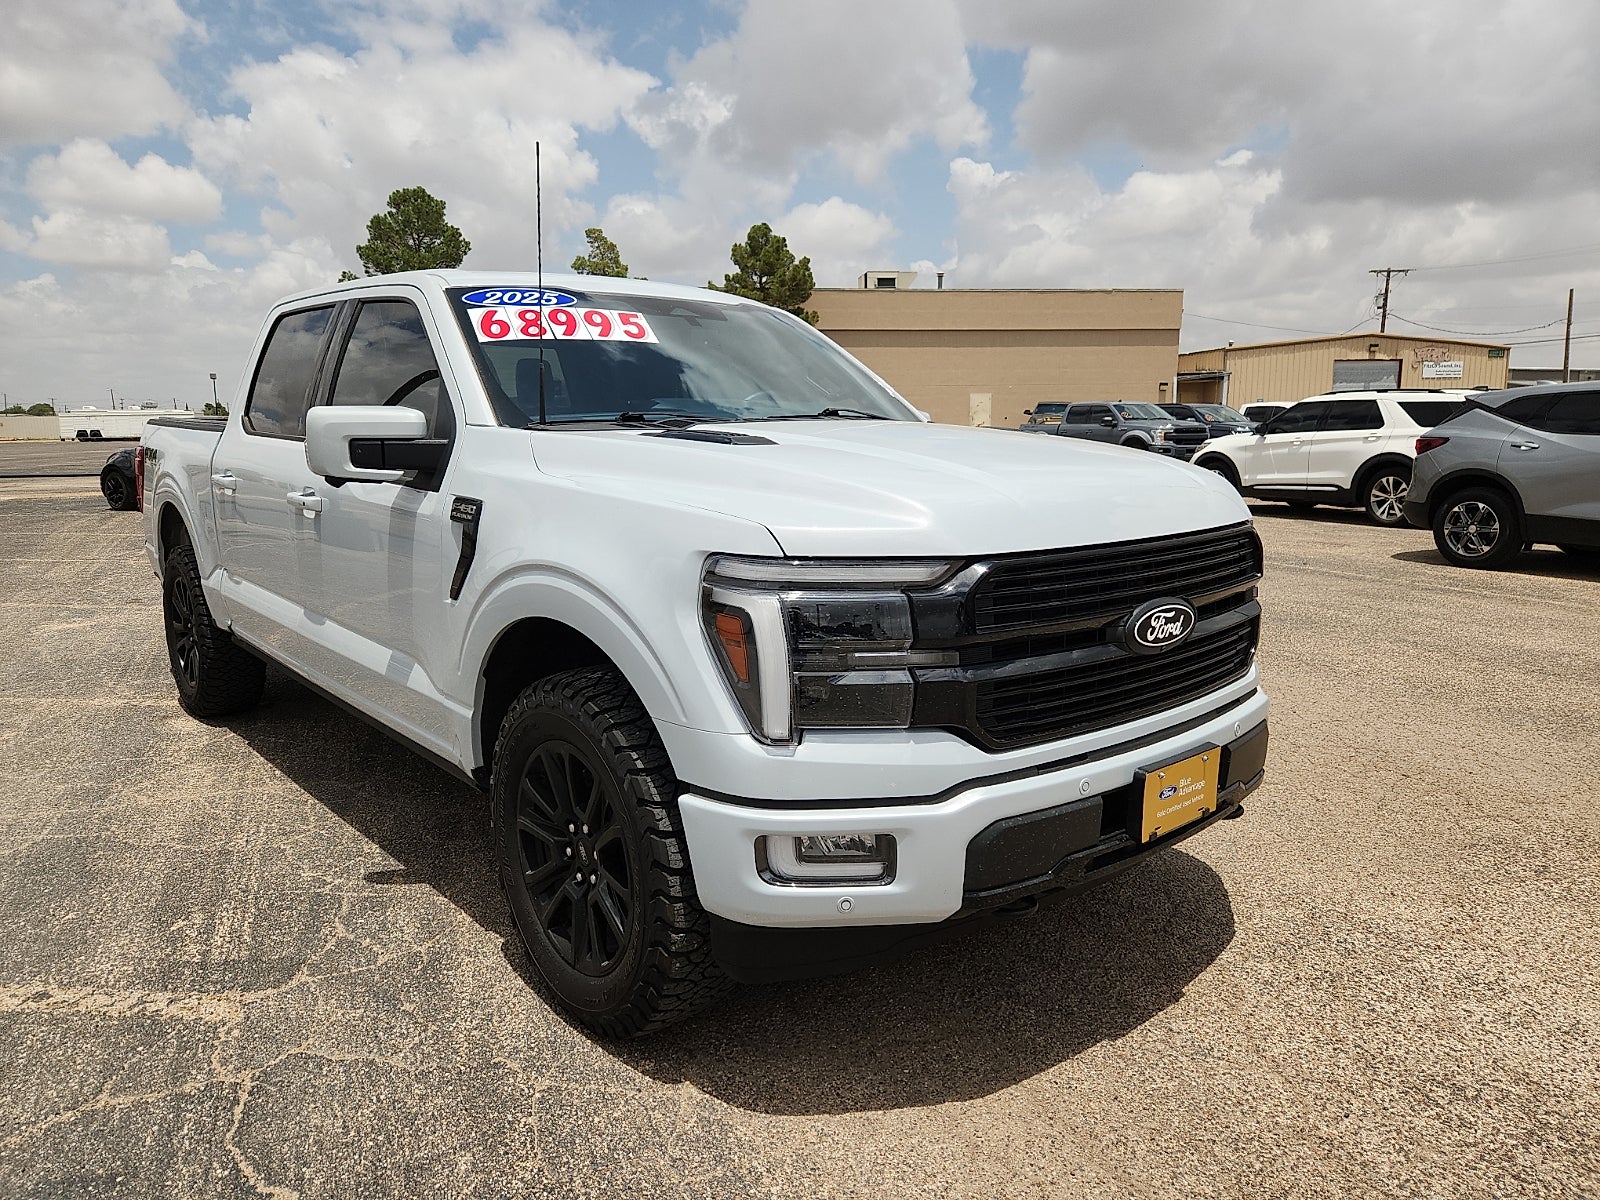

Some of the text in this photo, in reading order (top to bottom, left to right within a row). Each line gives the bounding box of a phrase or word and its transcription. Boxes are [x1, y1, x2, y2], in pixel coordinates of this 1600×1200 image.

[482, 291, 560, 306] 2025
[479, 308, 648, 340] 68995
[1146, 610, 1185, 642] Ford
[1178, 780, 1206, 797] Advantage
[1179, 777, 1192, 787] Blue
